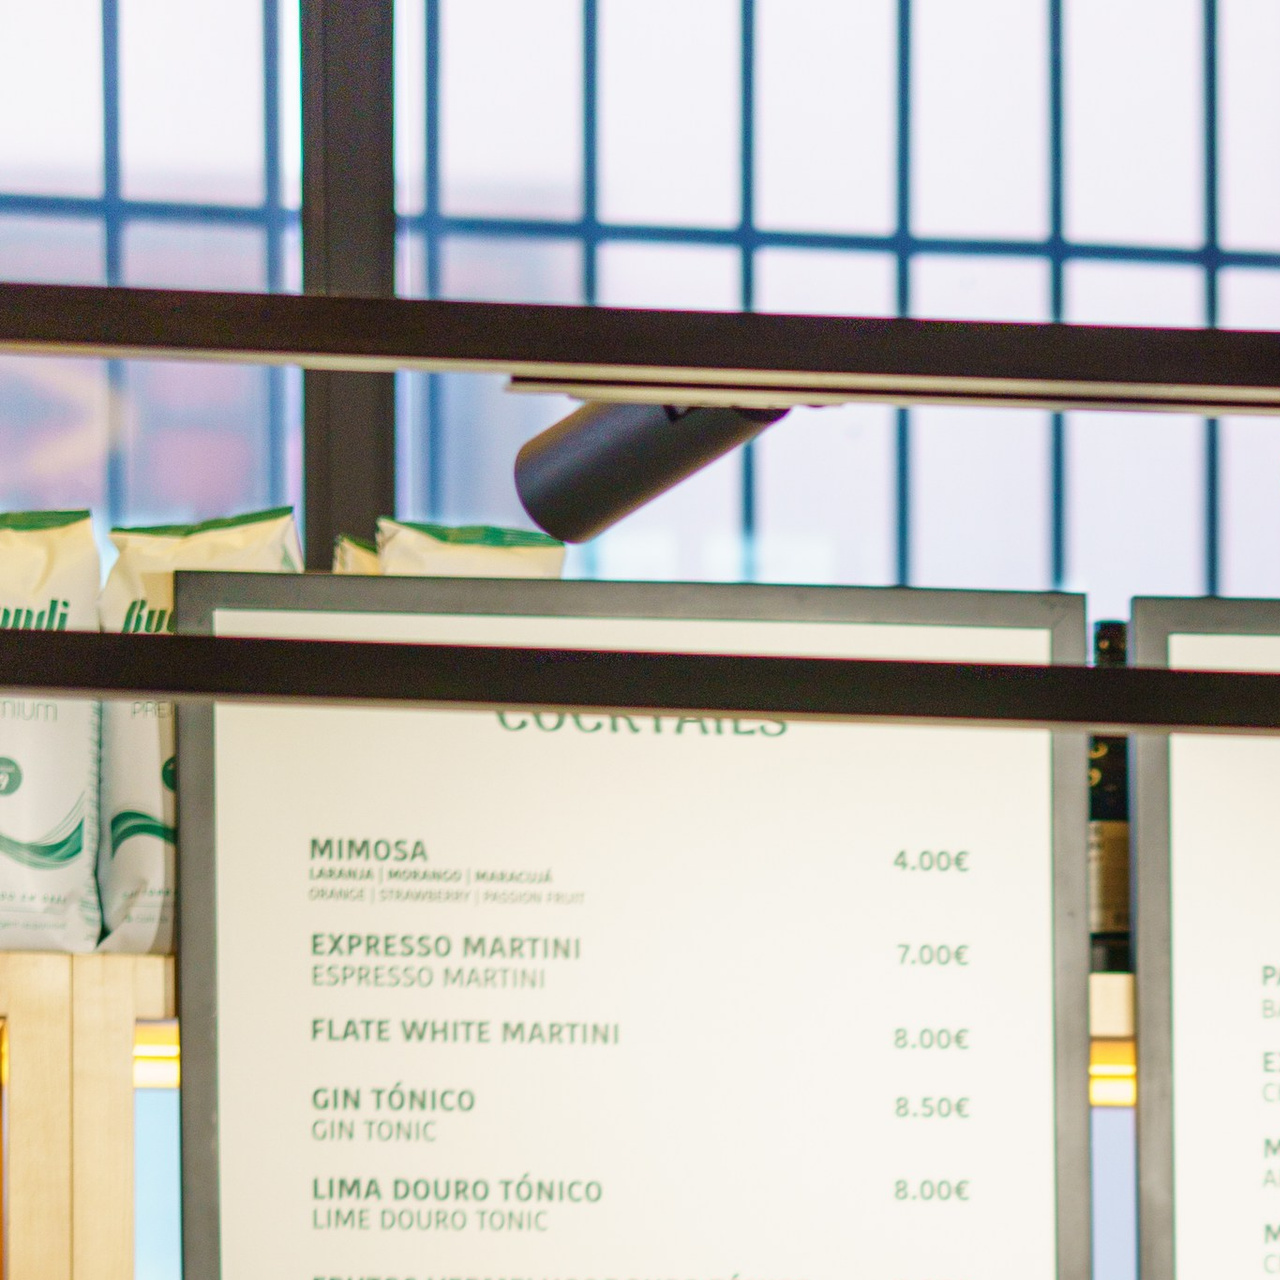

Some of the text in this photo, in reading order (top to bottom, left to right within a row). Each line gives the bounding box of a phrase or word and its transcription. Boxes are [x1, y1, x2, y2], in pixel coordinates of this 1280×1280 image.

[310, 838, 427, 861] MIMOSA
[893, 850, 969, 872] 4.00€
[309, 867, 552, 884] LARANJA MORANGO MARACUJÁ
[308, 887, 364, 901] ORANGE
[379, 888, 470, 903] STRAWBERRY
[311, 933, 580, 959] EXPRESSO MARTINI
[897, 944, 969, 966] 7.00€
[312, 964, 544, 989] ESPRESSO MARTINI
[312, 1019, 619, 1044] FLATE WHITE MARTINI
[894, 1028, 970, 1050] 8.00€
[312, 1082, 475, 1111] GIN TÓNICO
[895, 1097, 970, 1118] 8.50€
[312, 1119, 435, 1142] GIN TONIC
[313, 1173, 602, 1203] LIMA DOURO TÓNICO
[894, 1179, 970, 1201] 8.00€
[313, 1208, 547, 1231] LIME DOURO TONIC
